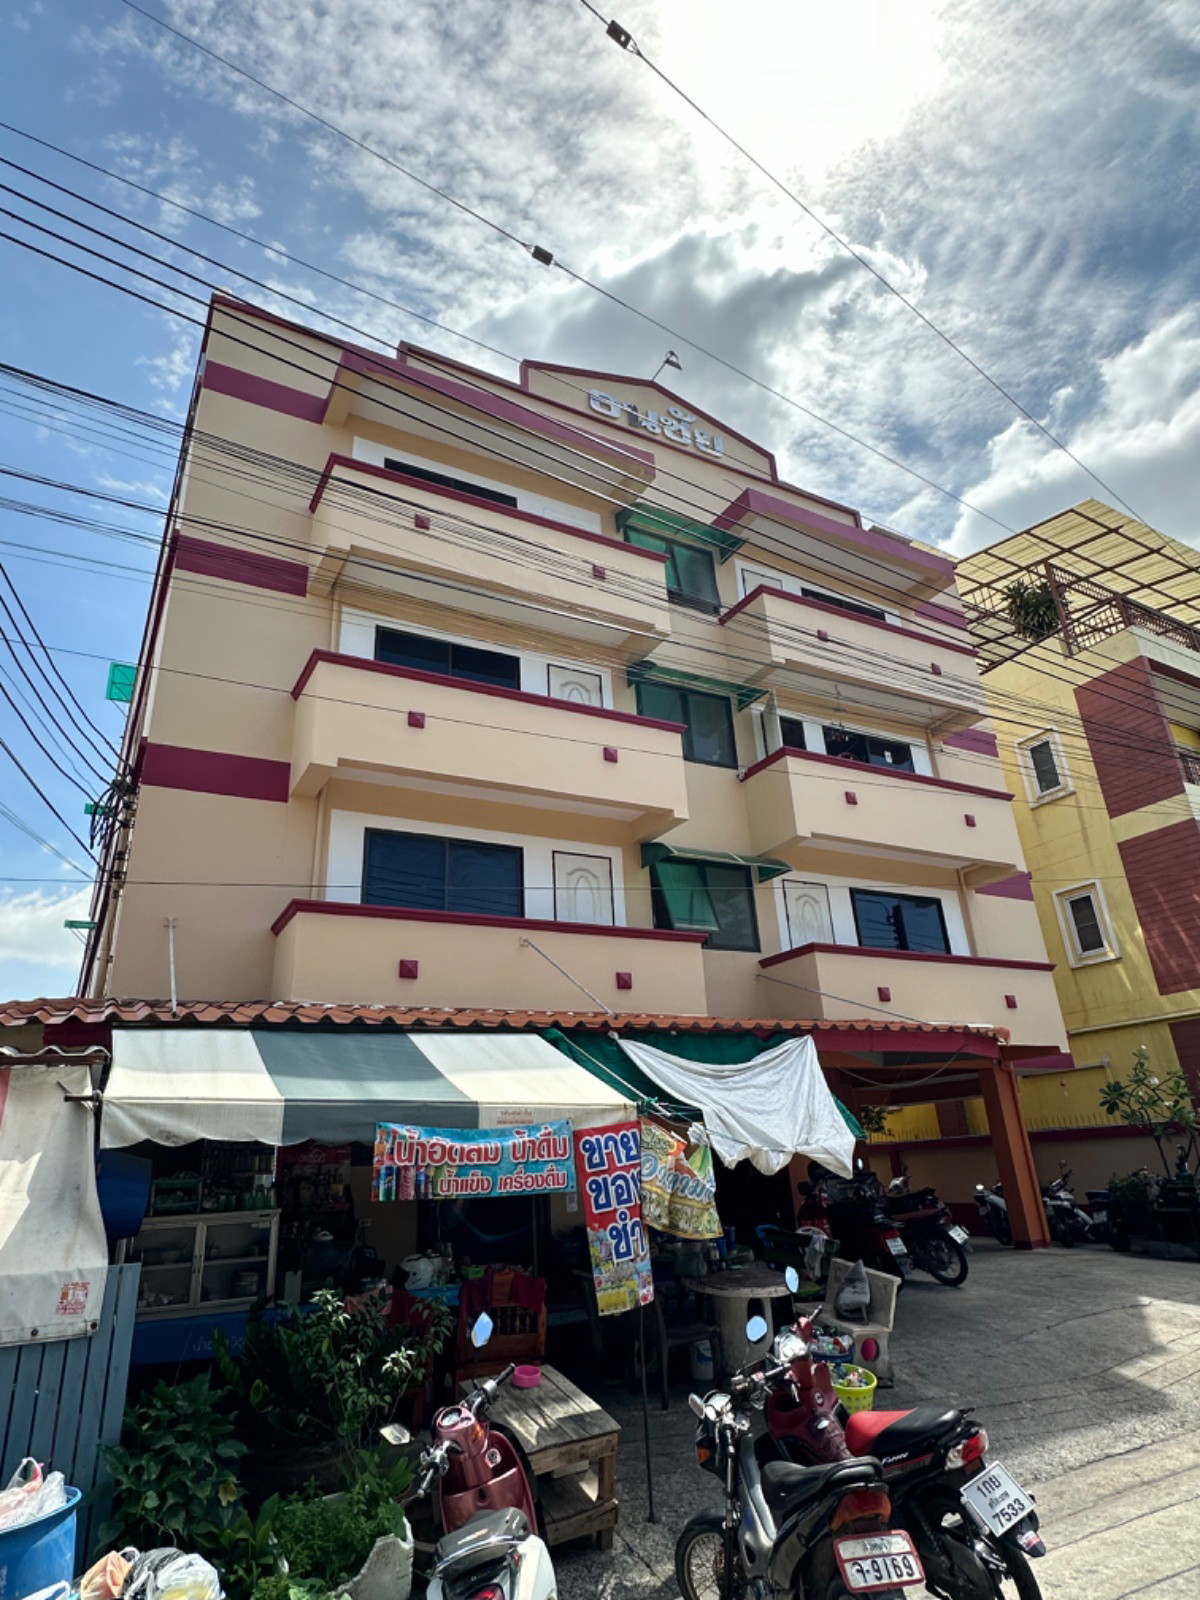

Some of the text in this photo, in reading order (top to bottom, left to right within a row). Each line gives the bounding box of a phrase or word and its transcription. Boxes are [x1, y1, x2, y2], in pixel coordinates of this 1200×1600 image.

[396, 1125, 568, 1166] น้ำอัดลม น้ำดื่ม
[581, 1130, 640, 1172] ขาย
[439, 1164, 567, 1195] น้ำแข็ง เครื่องดื่ม
[608, 1209, 646, 1262] ชำ
[976, 1474, 1002, 1498] 1กย
[992, 1498, 1026, 1528] 7533
